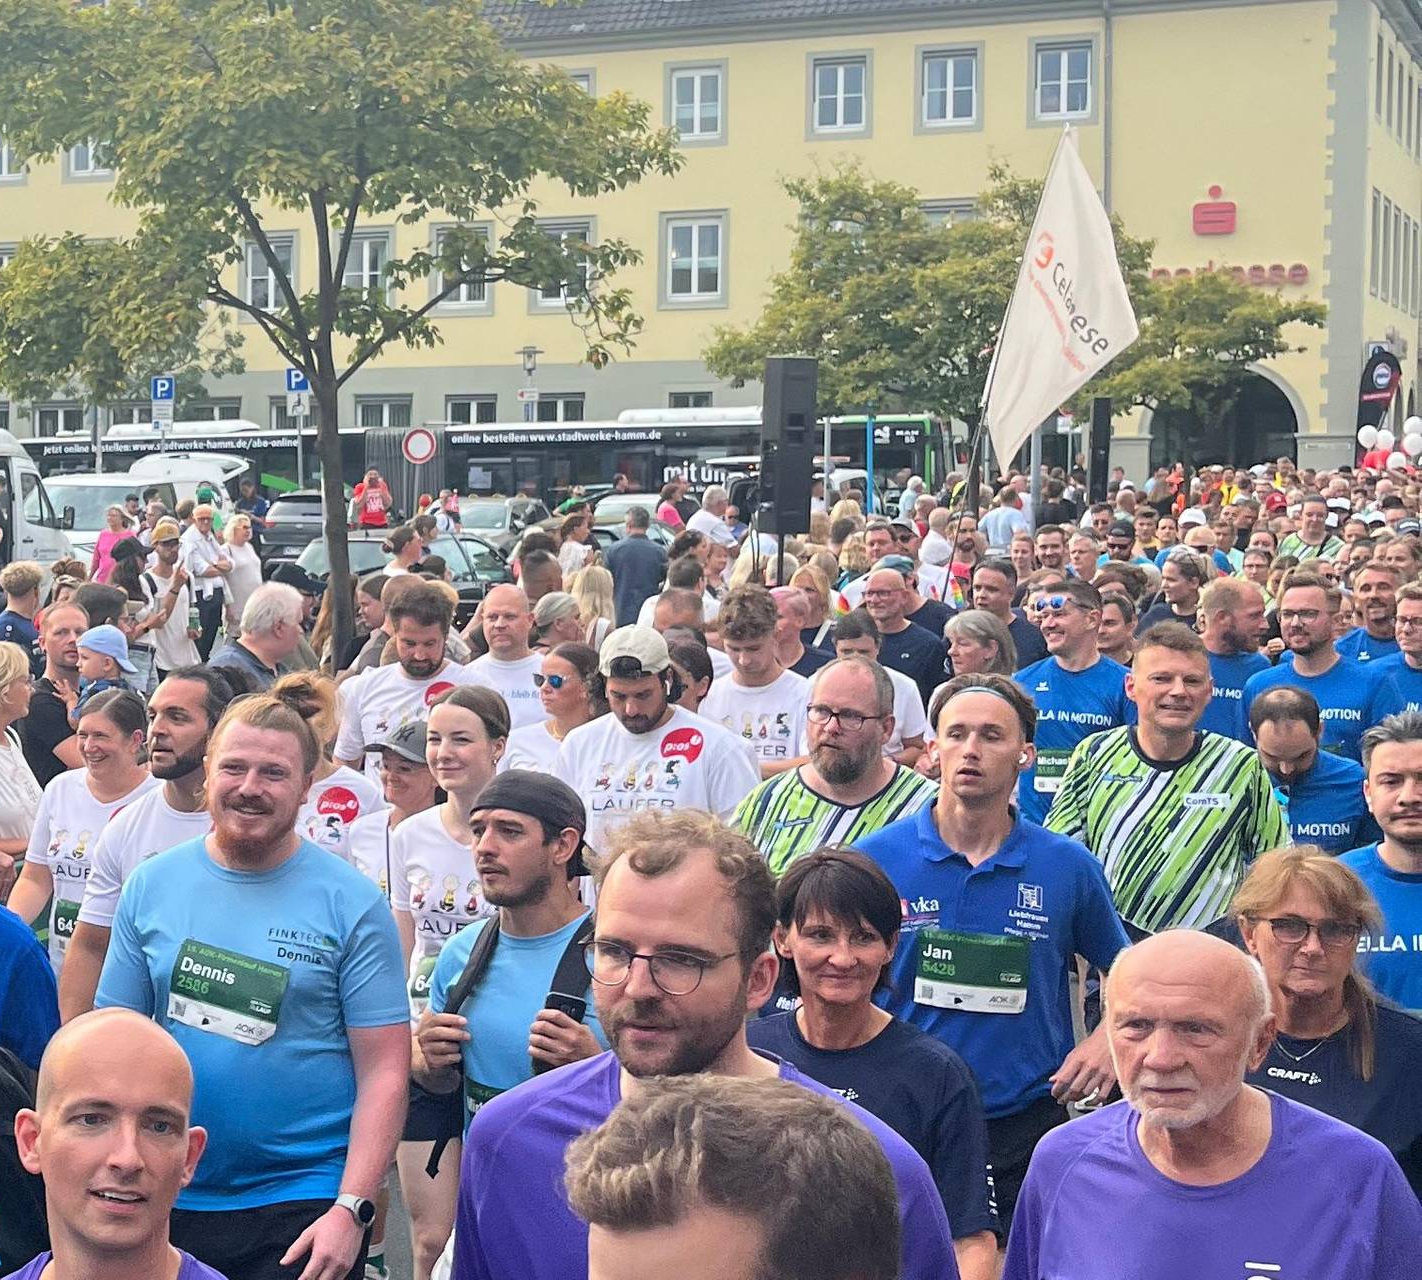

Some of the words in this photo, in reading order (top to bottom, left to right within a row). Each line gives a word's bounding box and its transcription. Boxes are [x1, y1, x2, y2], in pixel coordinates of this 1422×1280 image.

[291, 370, 304, 389] P
[157, 380, 169, 398] P
[91, 442, 131, 453] bstellen:
[132, 438, 298, 452] www.sadtwerke-hamm.de/abo-online
[451, 434, 481, 444] online
[663, 460, 698, 482] mit
[1071, 712, 1112, 727] MOTION
[1297, 823, 1351, 837] MOTION
[922, 943, 953, 961] Jan
[1356, 934, 1408, 953] ELLA
[277, 946, 322, 965] Dennis
[180, 956, 236, 985] Dennis
[921, 960, 956, 977] 5428
[177, 973, 210, 994] 2586
[1267, 1066, 1310, 1082] CRAFT
